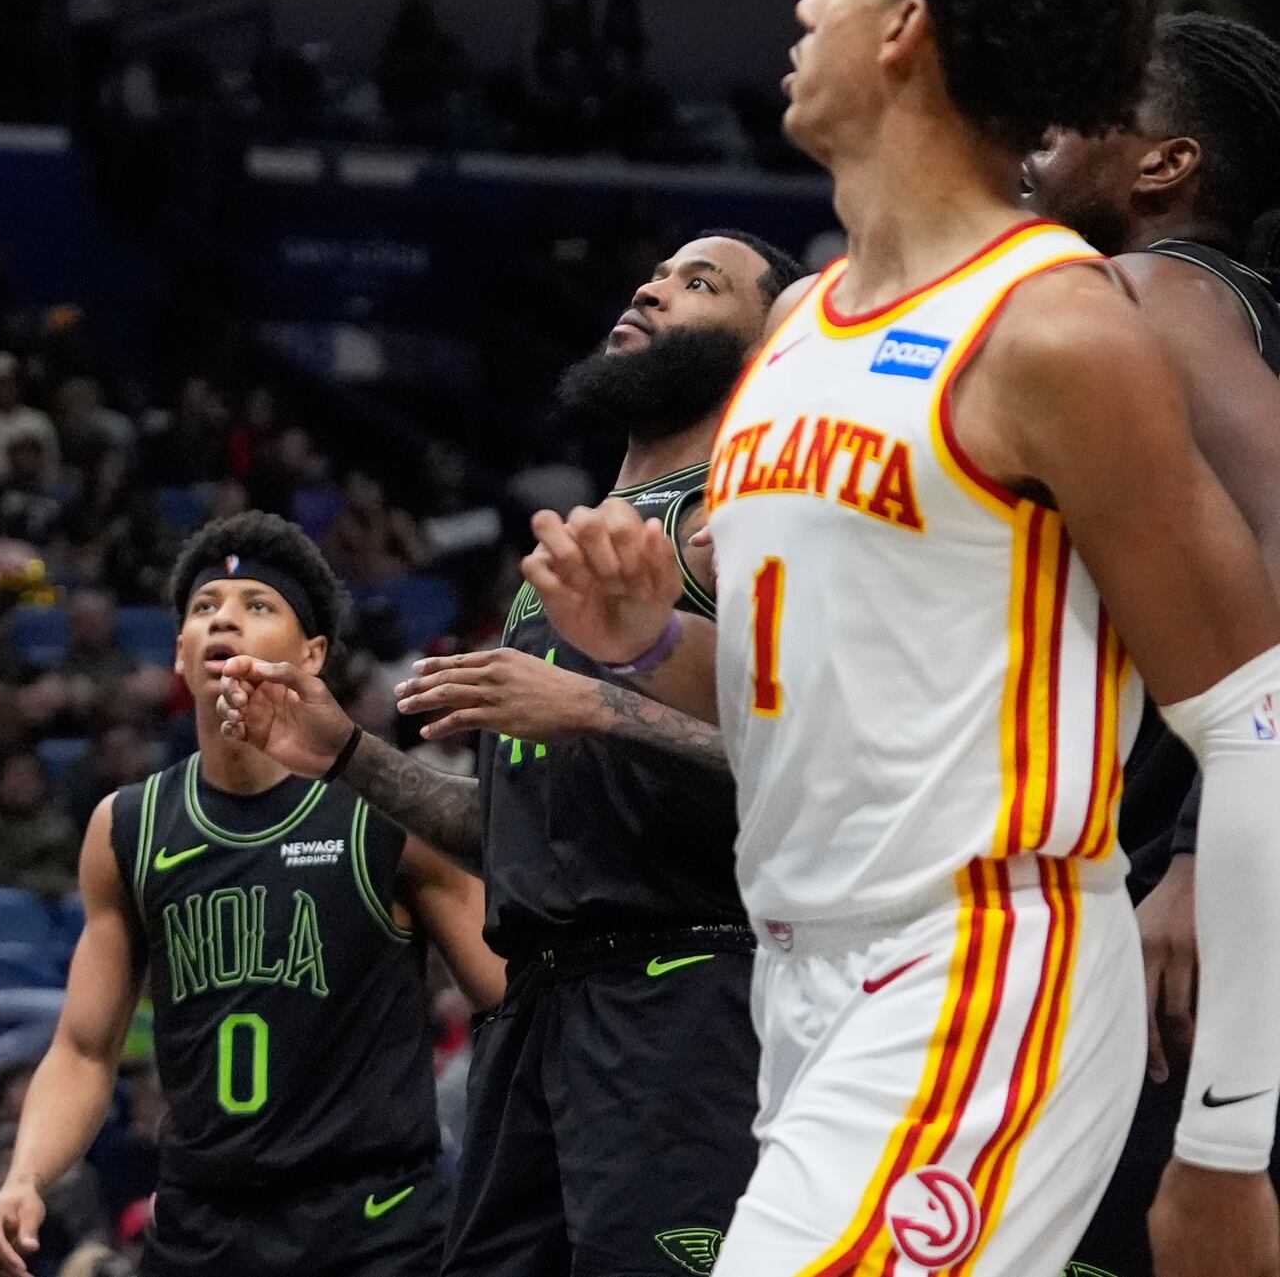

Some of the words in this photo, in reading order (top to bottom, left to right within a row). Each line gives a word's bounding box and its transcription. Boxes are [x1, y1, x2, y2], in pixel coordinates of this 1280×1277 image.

[752, 555, 785, 716] 1
[281, 839, 344, 858] NEWAGE
[285, 853, 338, 867] PRODUCTS
[163, 886, 328, 1003] NOLA
[218, 1013, 269, 1114] 0
